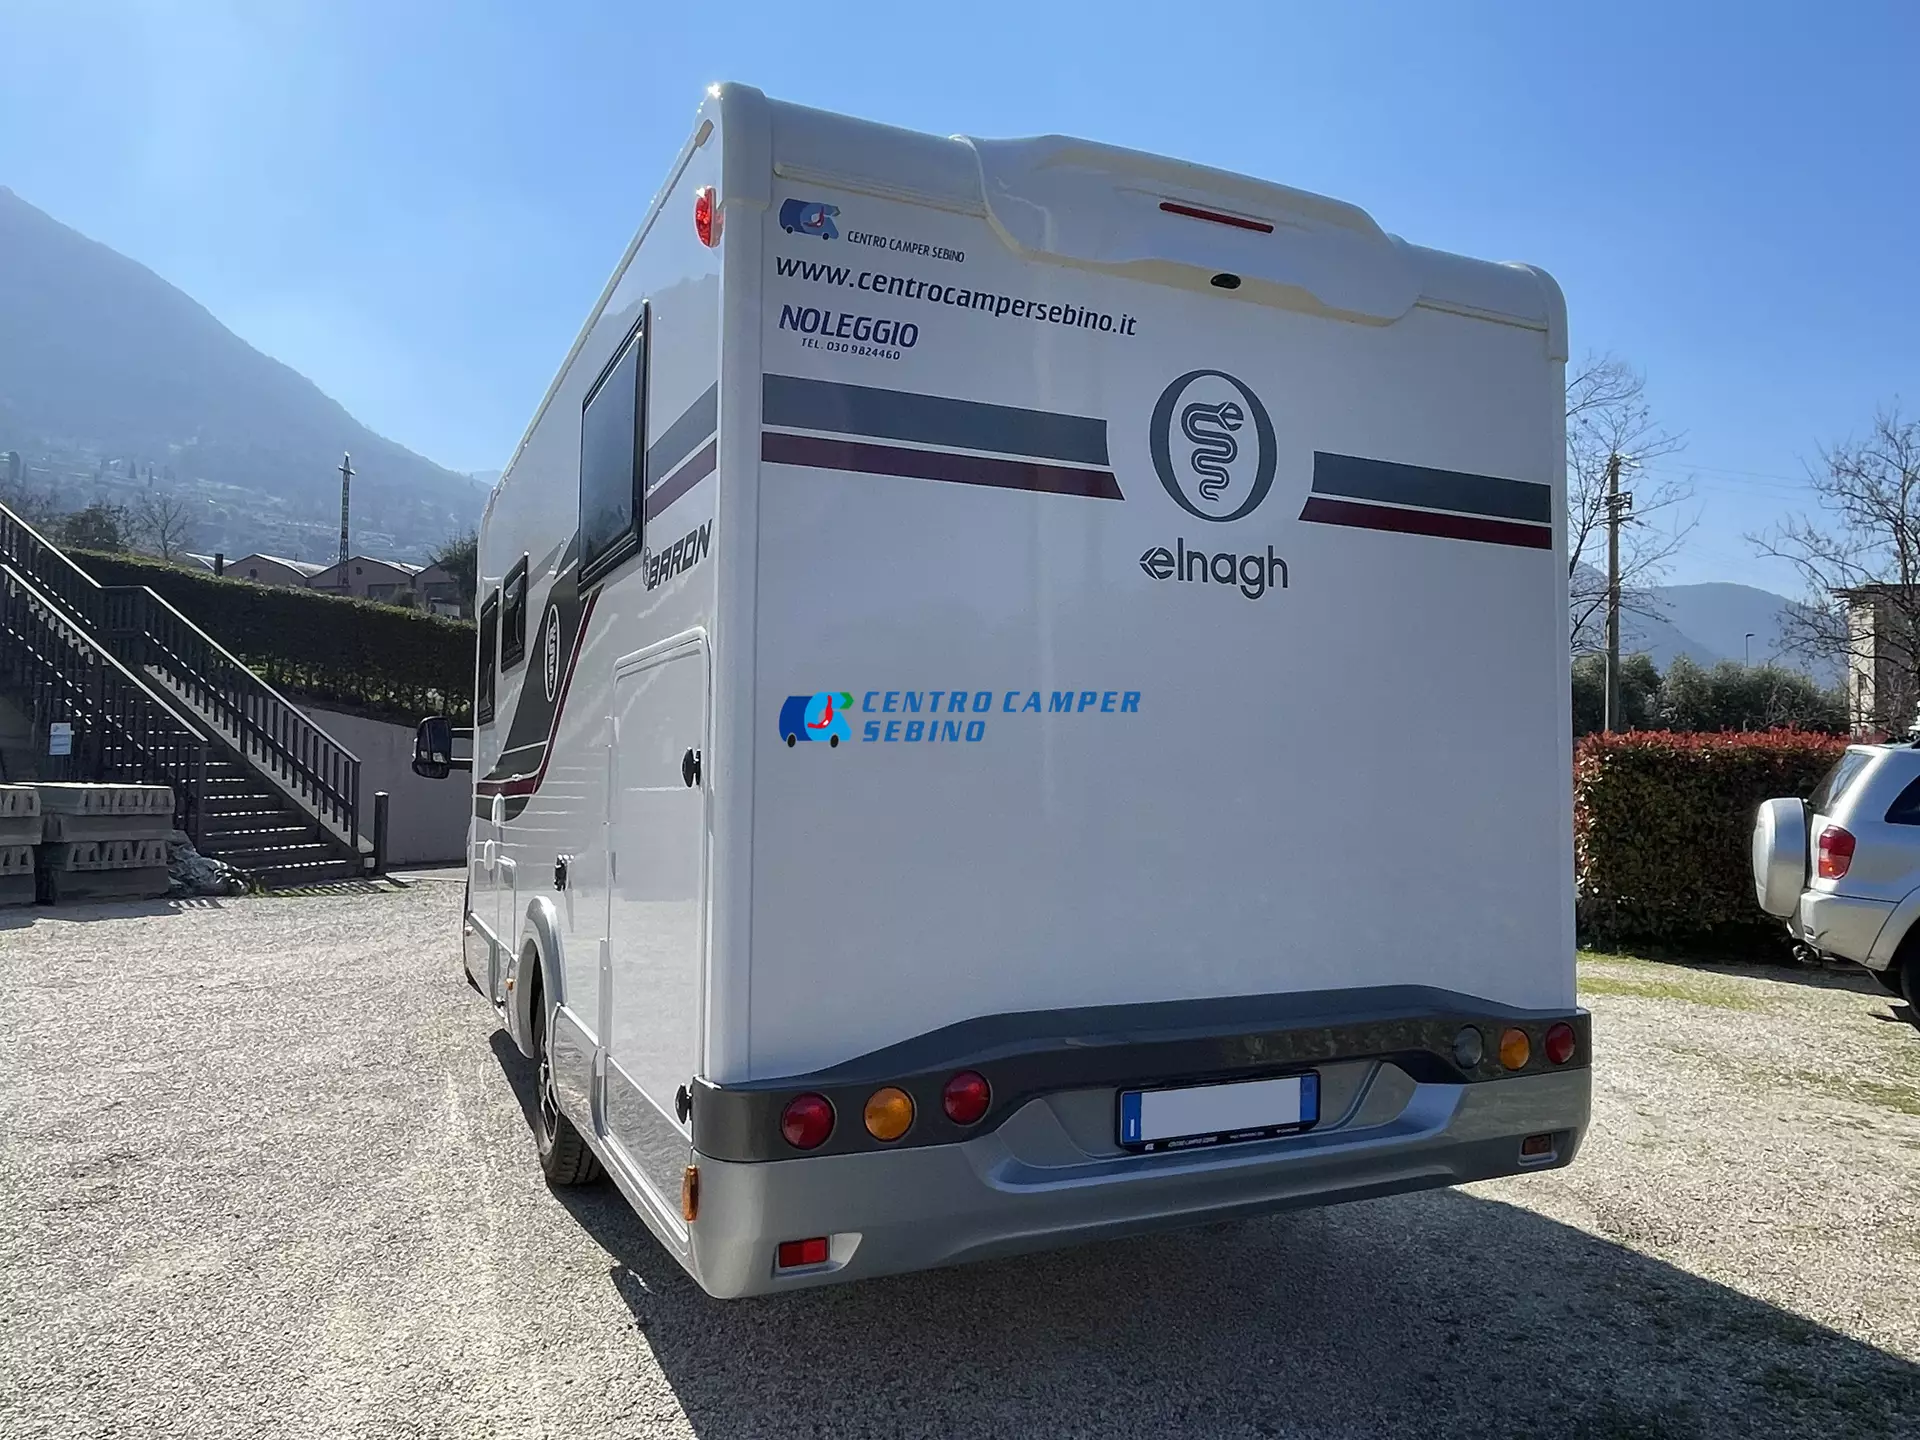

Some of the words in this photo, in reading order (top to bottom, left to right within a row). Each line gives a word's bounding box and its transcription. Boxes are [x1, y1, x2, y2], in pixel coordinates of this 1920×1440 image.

[847, 230, 887, 248] CENTRO
[889, 238, 930, 256] CAMPER
[931, 246, 965, 263] SEBINO
[775, 256, 1137, 336] www.centrocampersebino.it
[778, 304, 919, 349] NOLEGGIO
[801, 337, 824, 350] TEL.
[826, 341, 849, 353] 030
[850, 344, 901, 360] 9824460
[647, 518, 713, 592] BARON
[1139, 537, 1289, 600] elnagh
[861, 690, 993, 713] CENTRO
[1002, 690, 1142, 713] CAMPER
[861, 720, 986, 743] SEBINO
